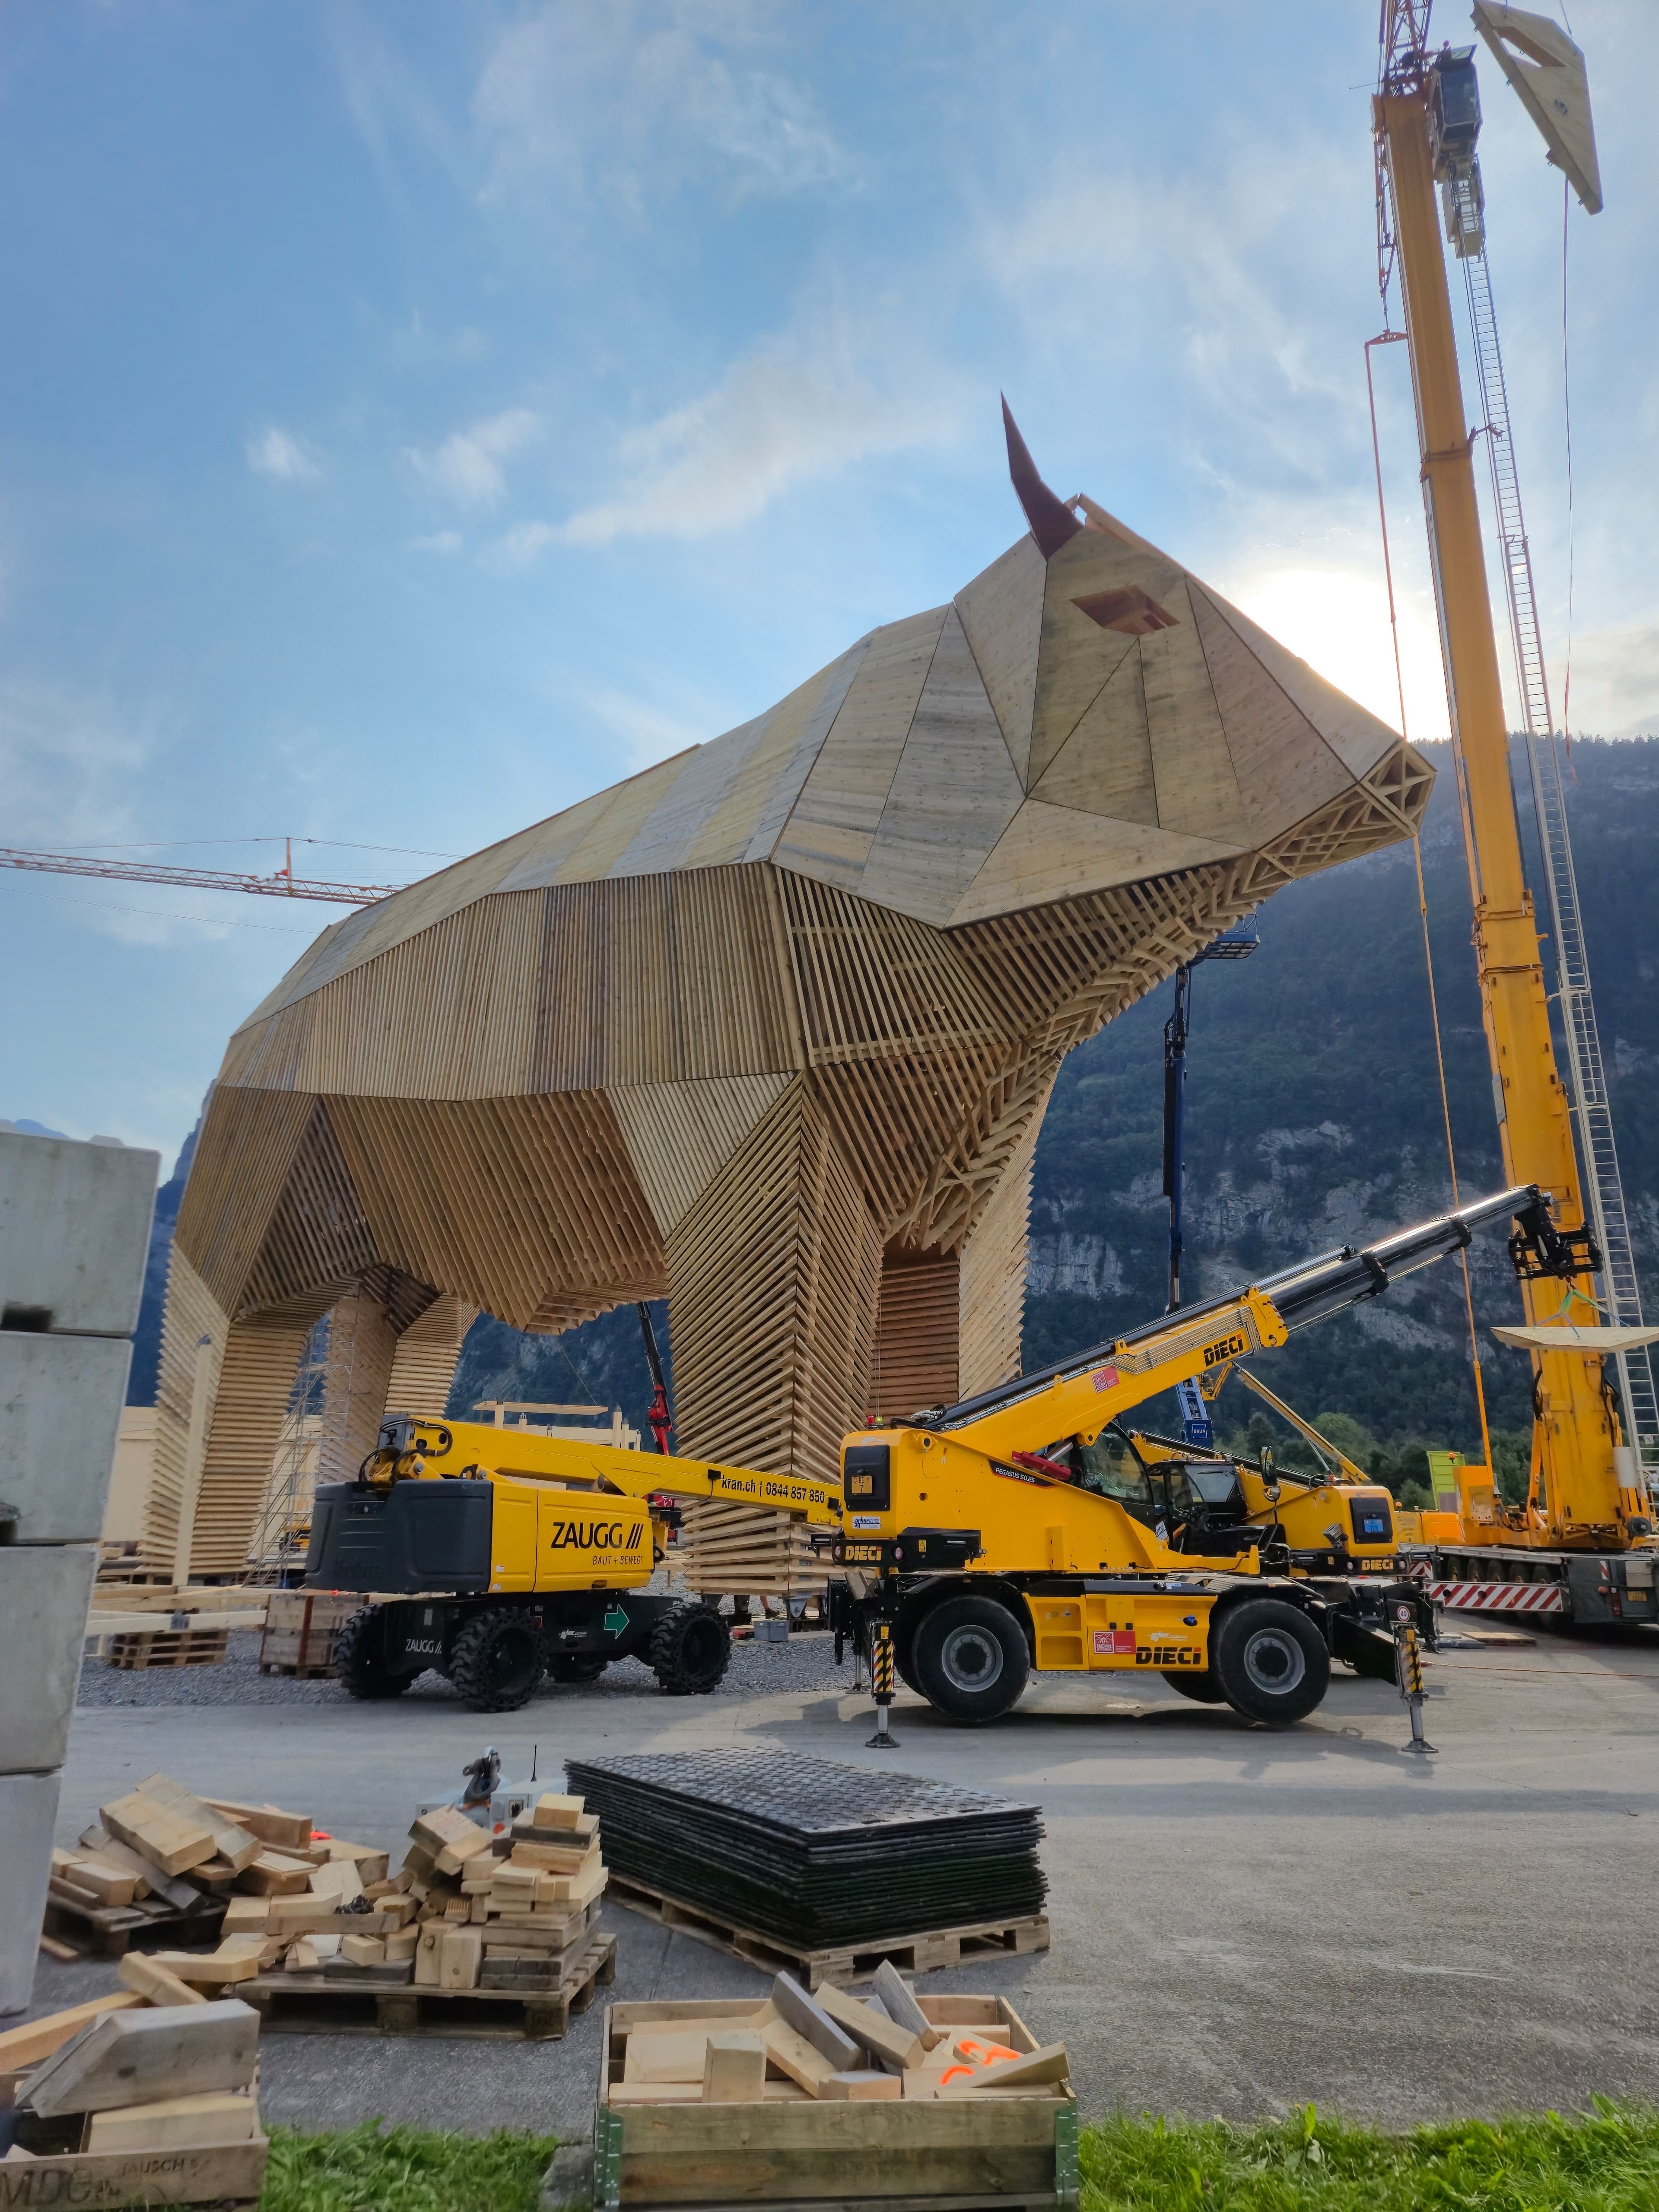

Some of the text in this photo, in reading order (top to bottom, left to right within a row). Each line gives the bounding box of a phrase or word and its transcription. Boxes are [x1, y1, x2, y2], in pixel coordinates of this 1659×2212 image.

[995, 1468, 1035, 1483] PEGASUS 50.25
[722, 1475, 755, 1493] kran.ch
[766, 1482, 789, 1498] 0844
[791, 1486, 807, 1501] 857
[809, 1489, 825, 1503] 850
[551, 1522, 623, 1549] ZAUGG
[405, 1638, 434, 1653] ZAUGG
